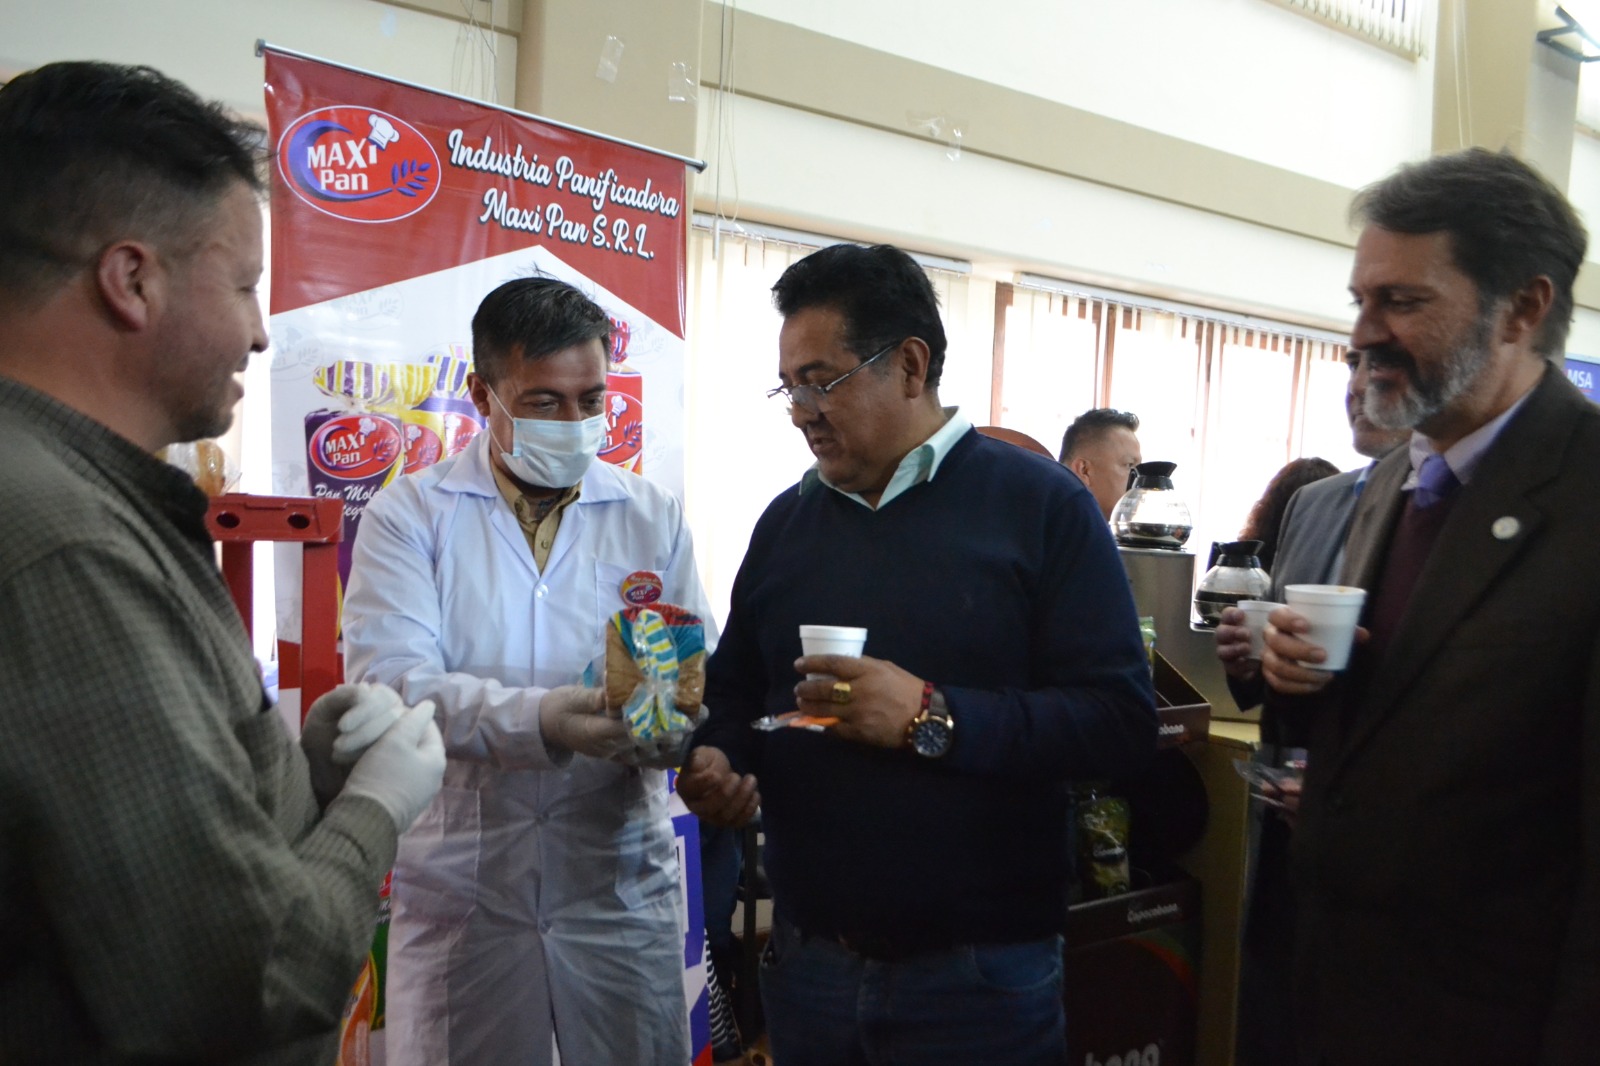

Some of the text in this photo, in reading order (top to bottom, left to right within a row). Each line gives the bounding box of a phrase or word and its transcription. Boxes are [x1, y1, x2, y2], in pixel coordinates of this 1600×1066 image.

[320, 169, 368, 191] Pan
[448, 129, 679, 216] Industria Panificadora
[480, 187, 655, 259] Maxi Pan S.R.L.
[332, 452, 361, 467] Pan
[315, 484, 342, 499] Pan
